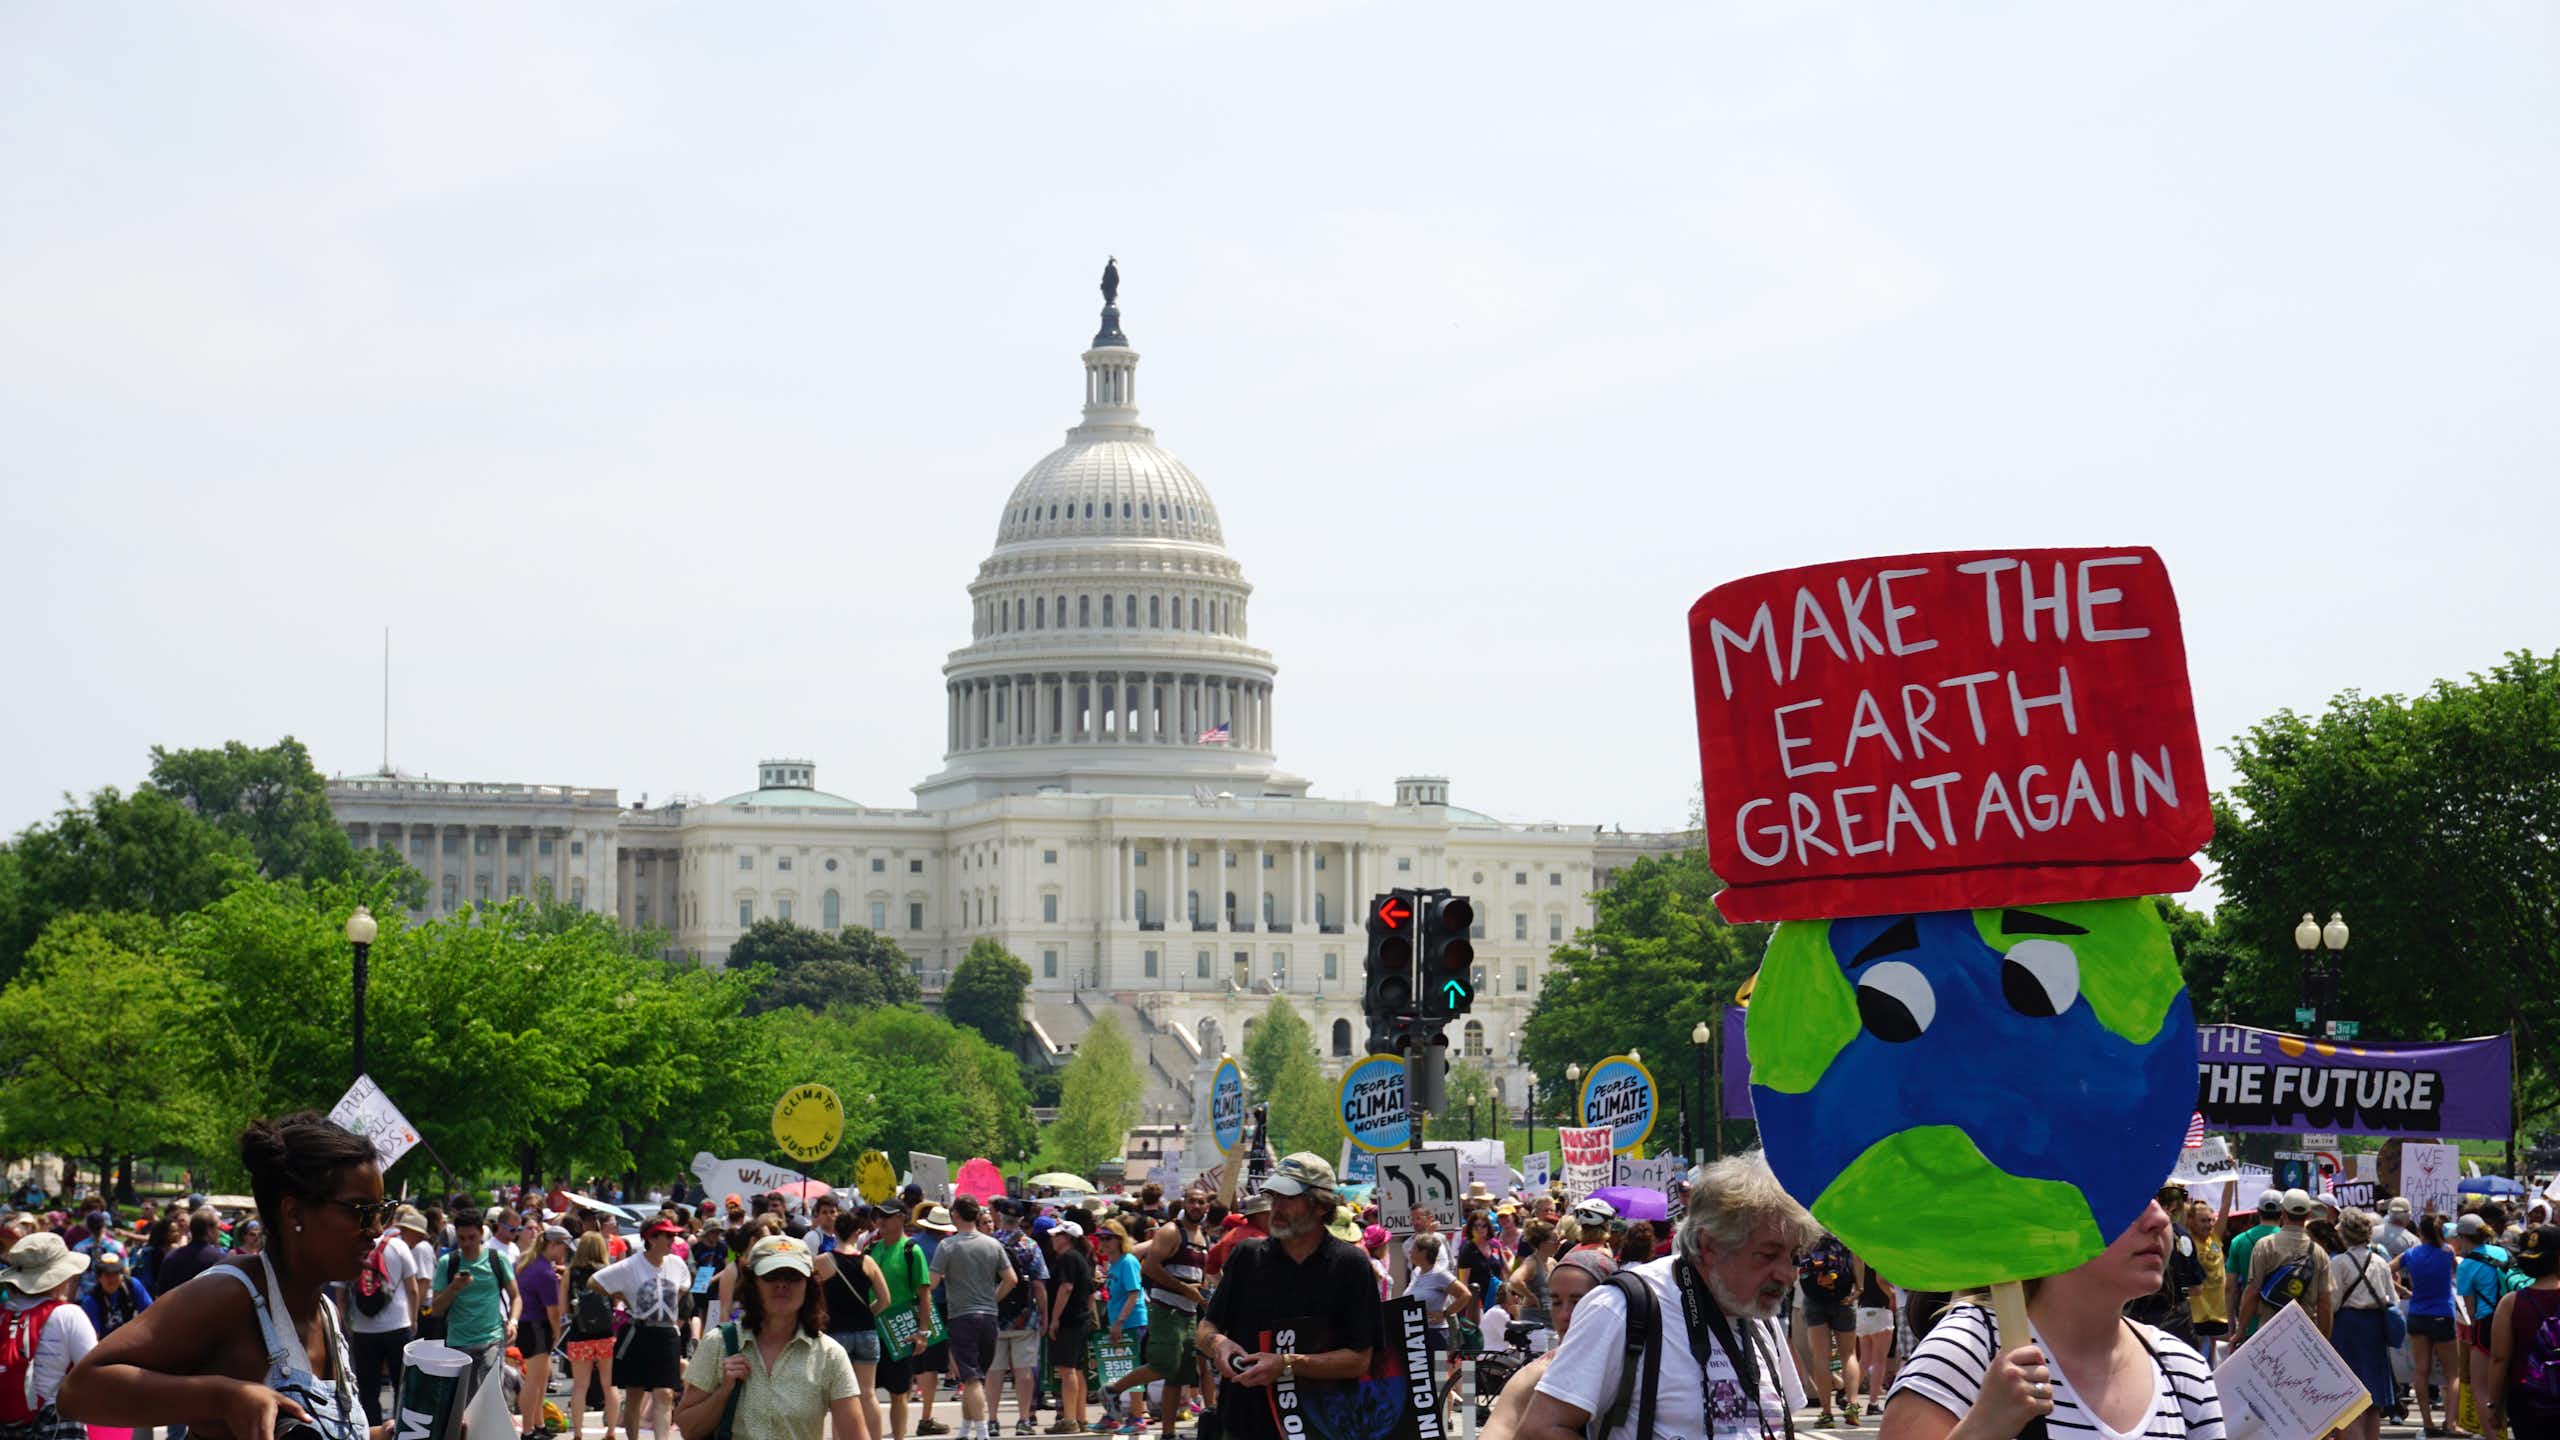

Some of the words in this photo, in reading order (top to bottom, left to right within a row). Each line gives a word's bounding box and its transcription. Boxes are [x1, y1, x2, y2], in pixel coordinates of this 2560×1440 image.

[1710, 568, 1938, 699] MAKE
[1956, 557, 2150, 647] THE
[1774, 666, 2077, 779] EARTH
[1736, 772, 1962, 866] GREAT
[1975, 745, 2179, 840] AGAIN
[2197, 1027, 2262, 1054] THE
[1594, 1075, 1638, 1099] PEOPLES
[2273, 1066, 2435, 1110] FUTURE
[783, 1090, 836, 1116] CLIMATE
[1345, 1088, 1404, 1122] CLIMAT
[1587, 1085, 1648, 1124] CLIMATE
[782, 1132, 833, 1157] JUSTICE
[2414, 1147, 2444, 1165] WE
[2407, 1176, 2449, 1193] PARIS
[1386, 1216, 1409, 1228] ONL
[1681, 1266, 1692, 1287] EOS
[1686, 1288, 1699, 1327] DIGITAL
[1104, 1360, 1133, 1370] RISE
[1403, 1307, 1435, 1409] CLIMATE
[1416, 1413, 1440, 1439] IN
